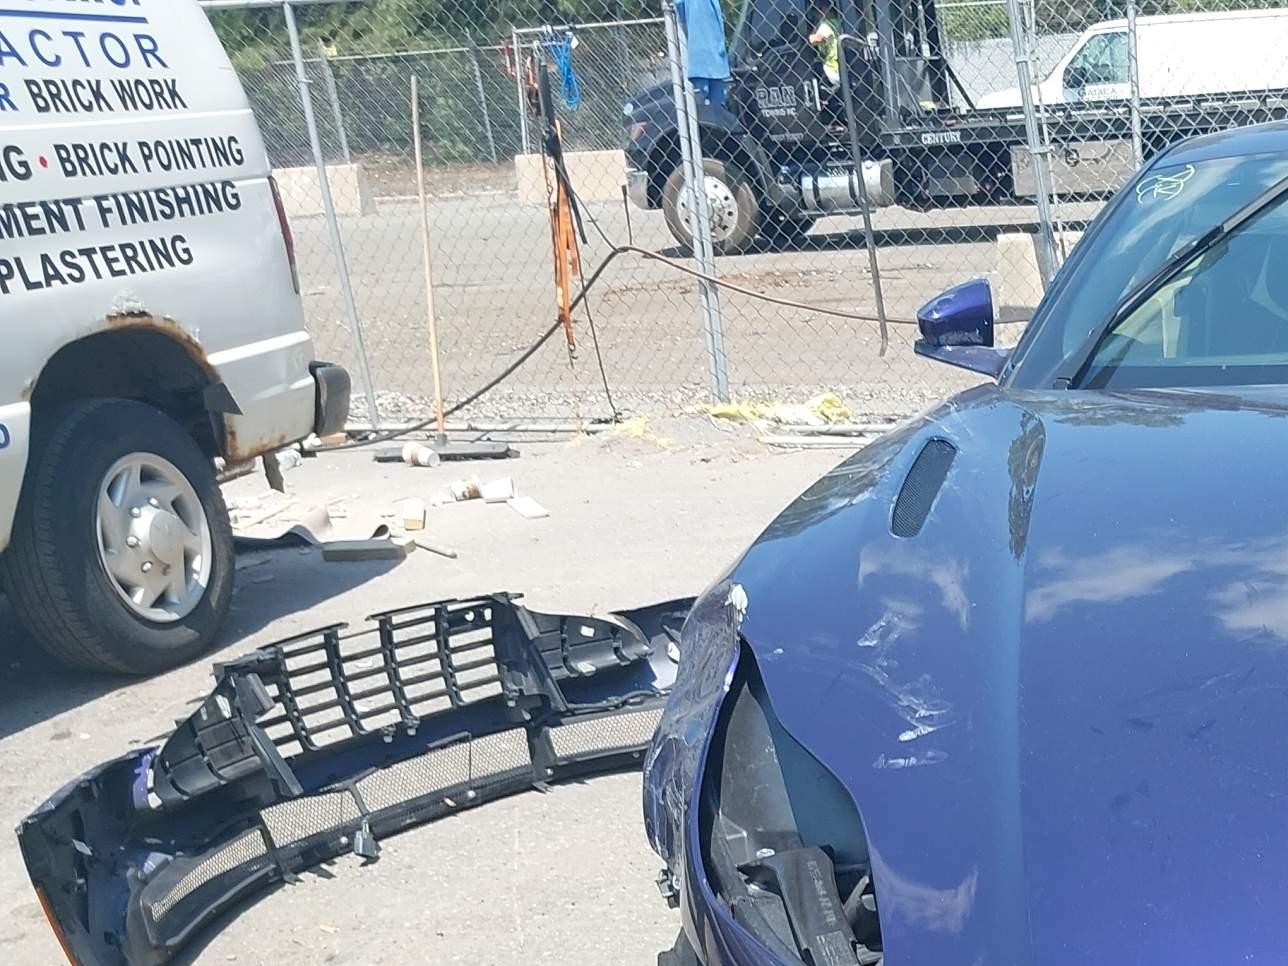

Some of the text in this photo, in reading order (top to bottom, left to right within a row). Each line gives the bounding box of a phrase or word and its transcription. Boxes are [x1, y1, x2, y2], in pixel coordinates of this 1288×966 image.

[23, 79, 115, 113] BRICK
[110, 78, 188, 111] WORK
[53, 142, 138, 178] BRICK
[138, 136, 244, 172] POINTING
[921, 131, 961, 145] CENTURY
[93, 180, 242, 229] FINISHING
[0, 235, 194, 294] PLASTERING
